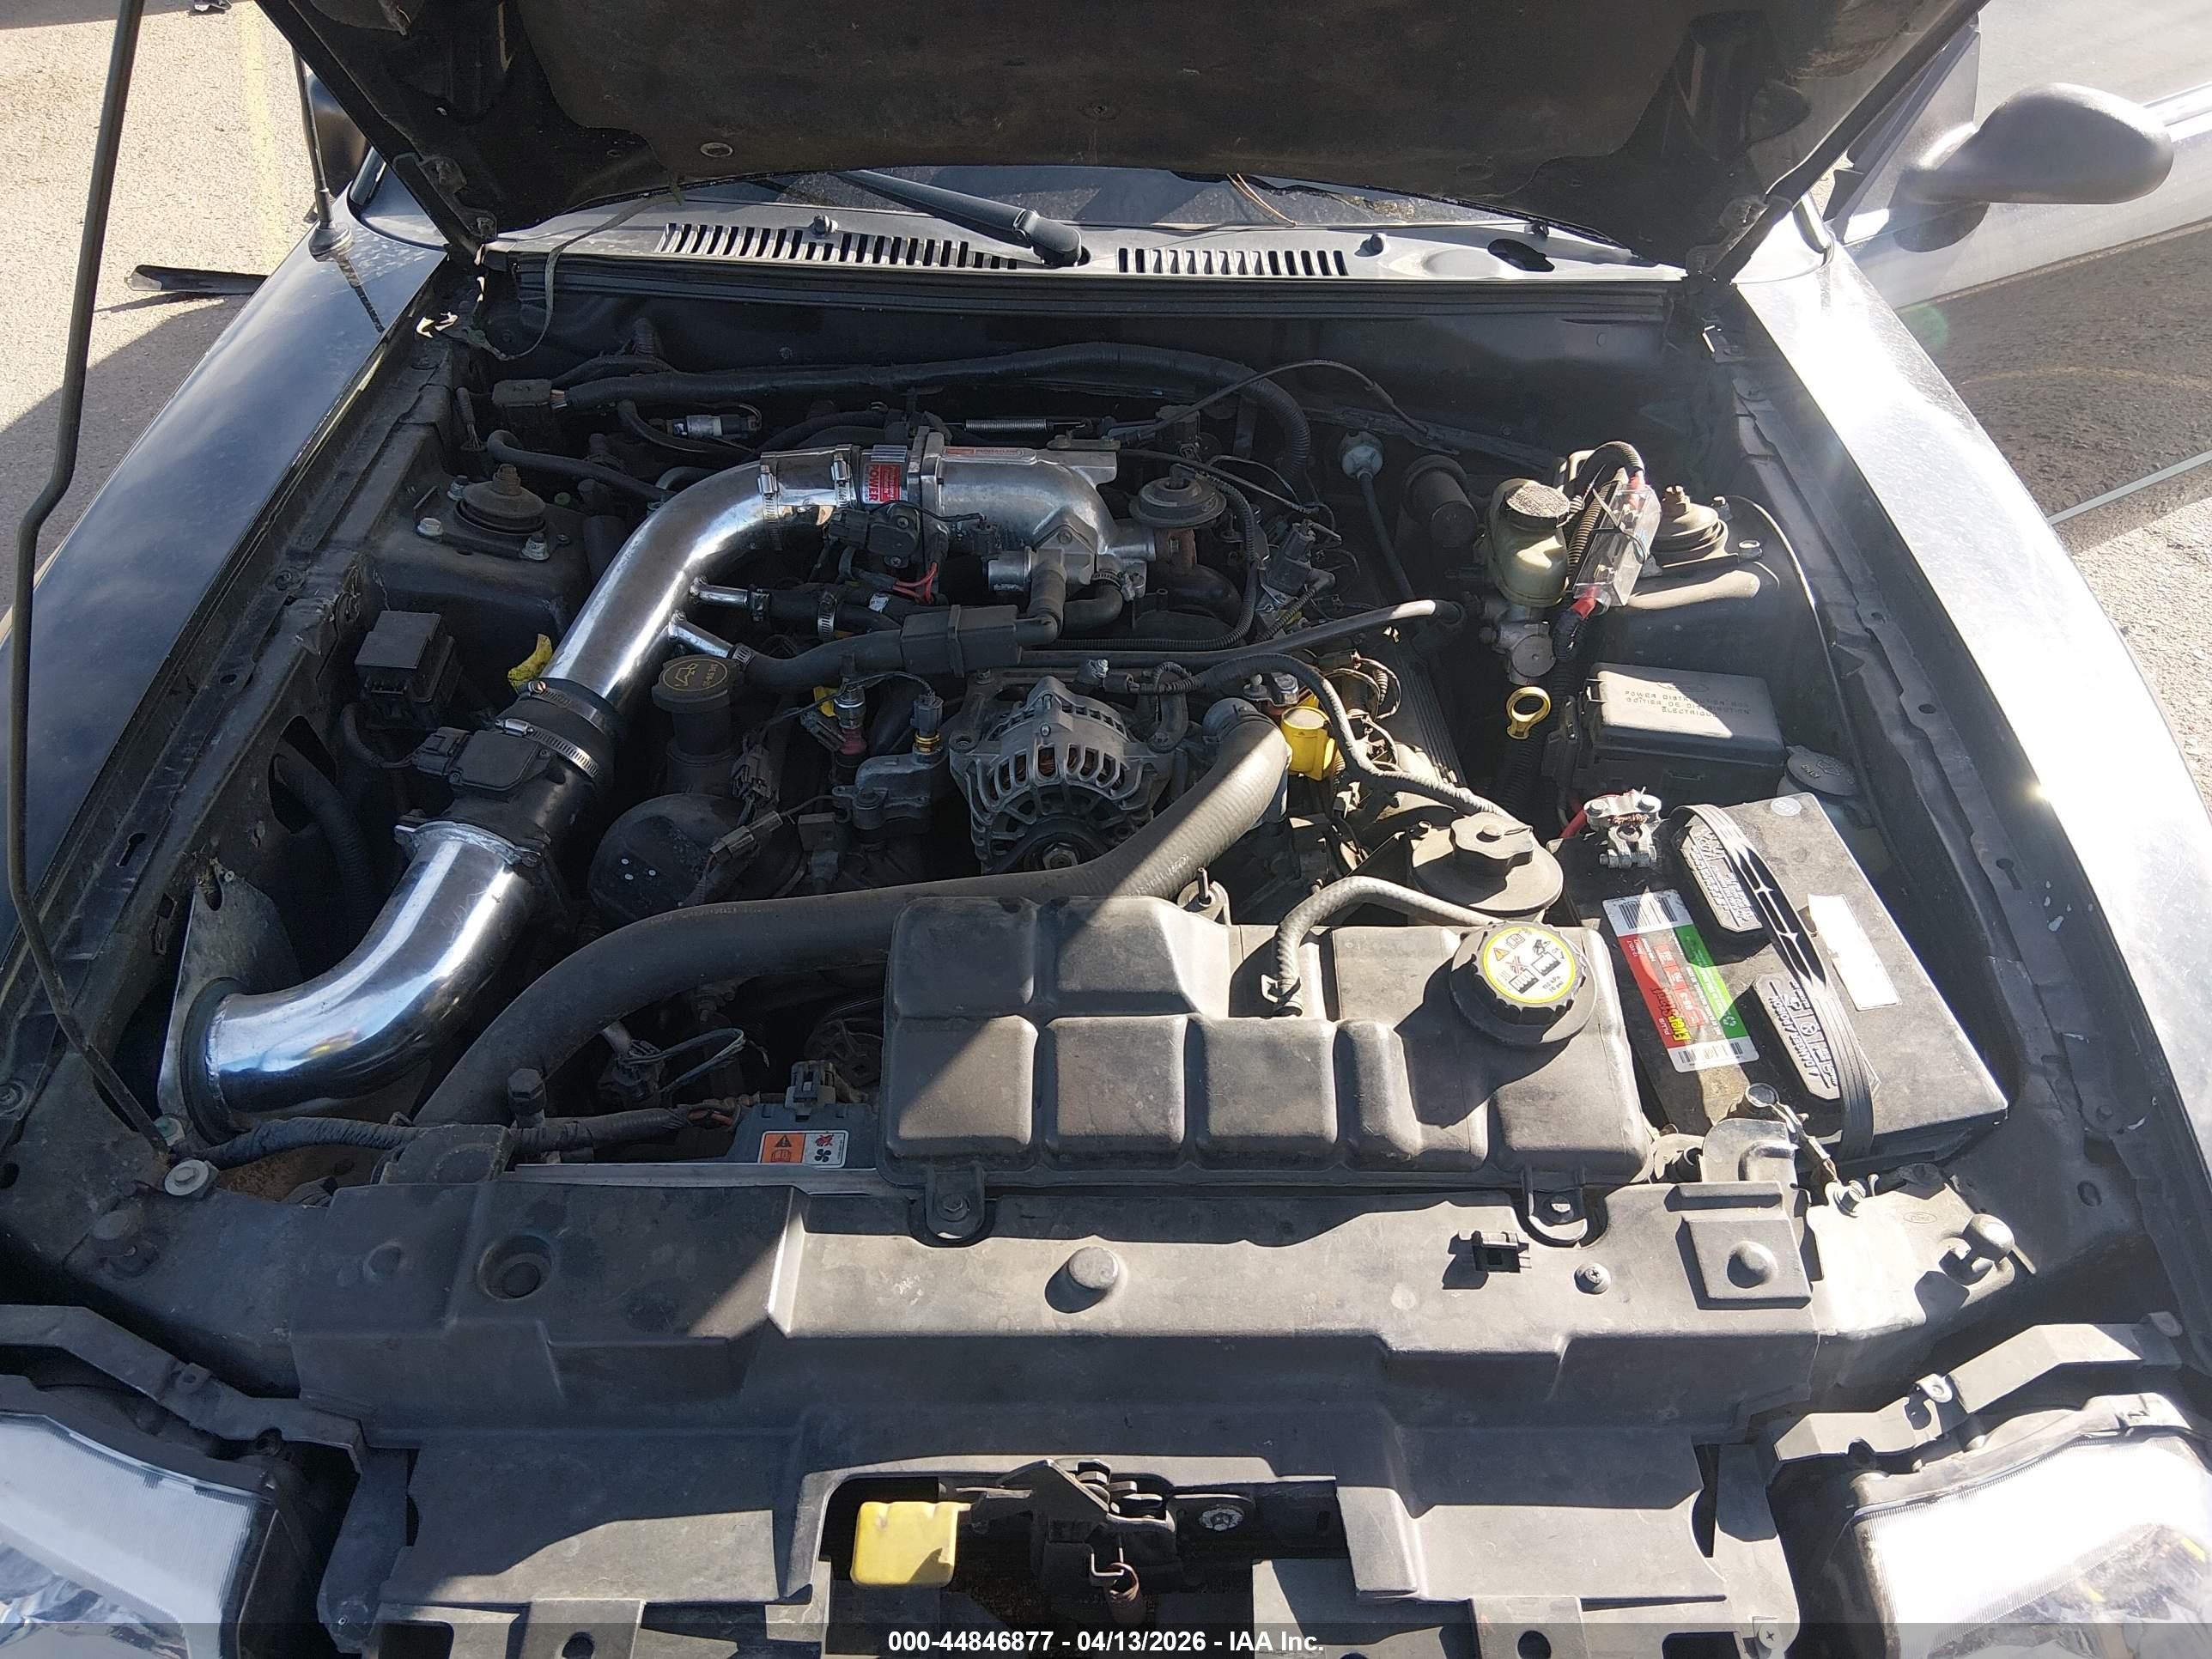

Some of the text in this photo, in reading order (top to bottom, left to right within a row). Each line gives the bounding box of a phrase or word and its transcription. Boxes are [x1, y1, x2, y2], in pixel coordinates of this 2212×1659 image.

[869, 465, 879, 501] POWER
[1625, 690, 1656, 699] POWER
[1658, 1018, 1669, 1036] PLUS
